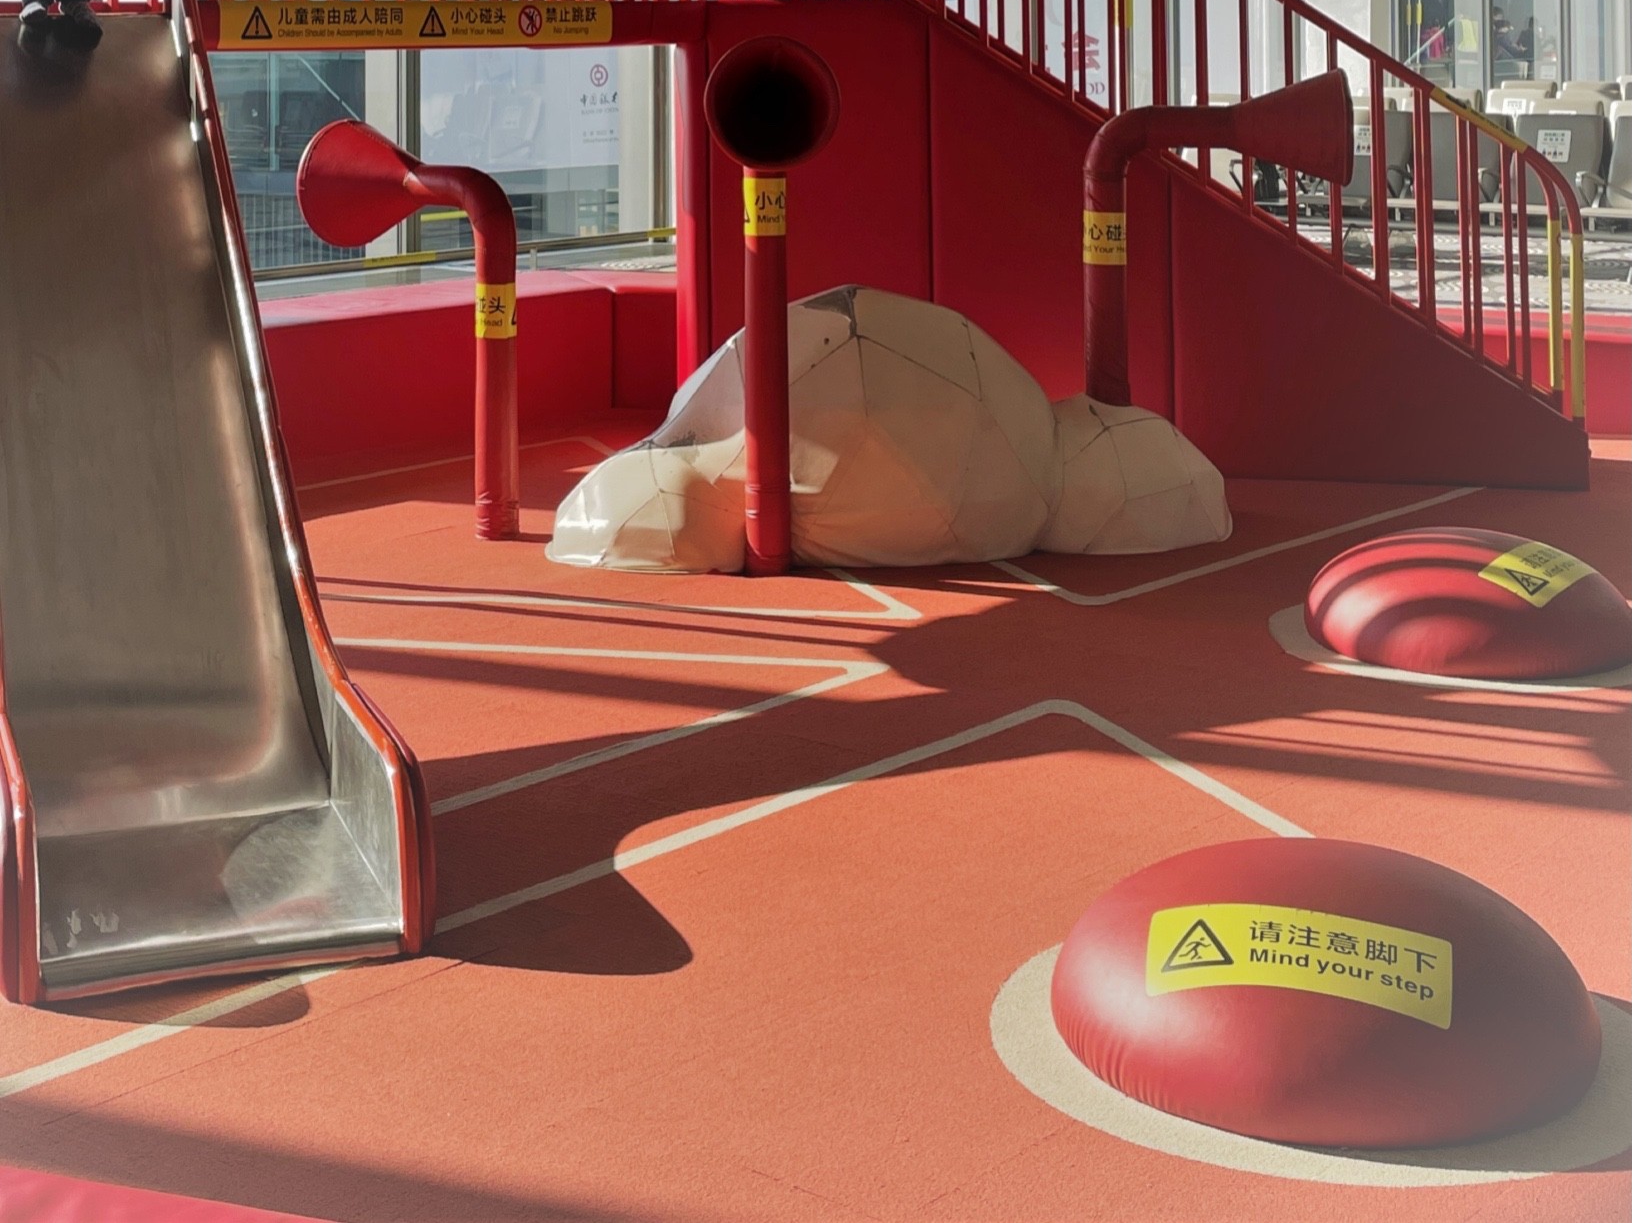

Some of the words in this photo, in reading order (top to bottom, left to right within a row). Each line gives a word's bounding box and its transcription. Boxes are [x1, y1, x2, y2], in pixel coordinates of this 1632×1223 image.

[278, 7, 403, 26] 儿童需由成人陪同
[451, 7, 506, 24] 小心碰头
[546, 7, 597, 23] 禁止跳跃
[452, 27, 468, 35] Mind
[470, 27, 485, 35] Your
[487, 27, 504, 35] Head
[563, 27, 589, 36] Jumping
[1249, 920, 1438, 974] 请注意脚下
[1249, 948, 1309, 968] Mind
[1317, 959, 1374, 982] your
[1380, 972, 1435, 1001] step
